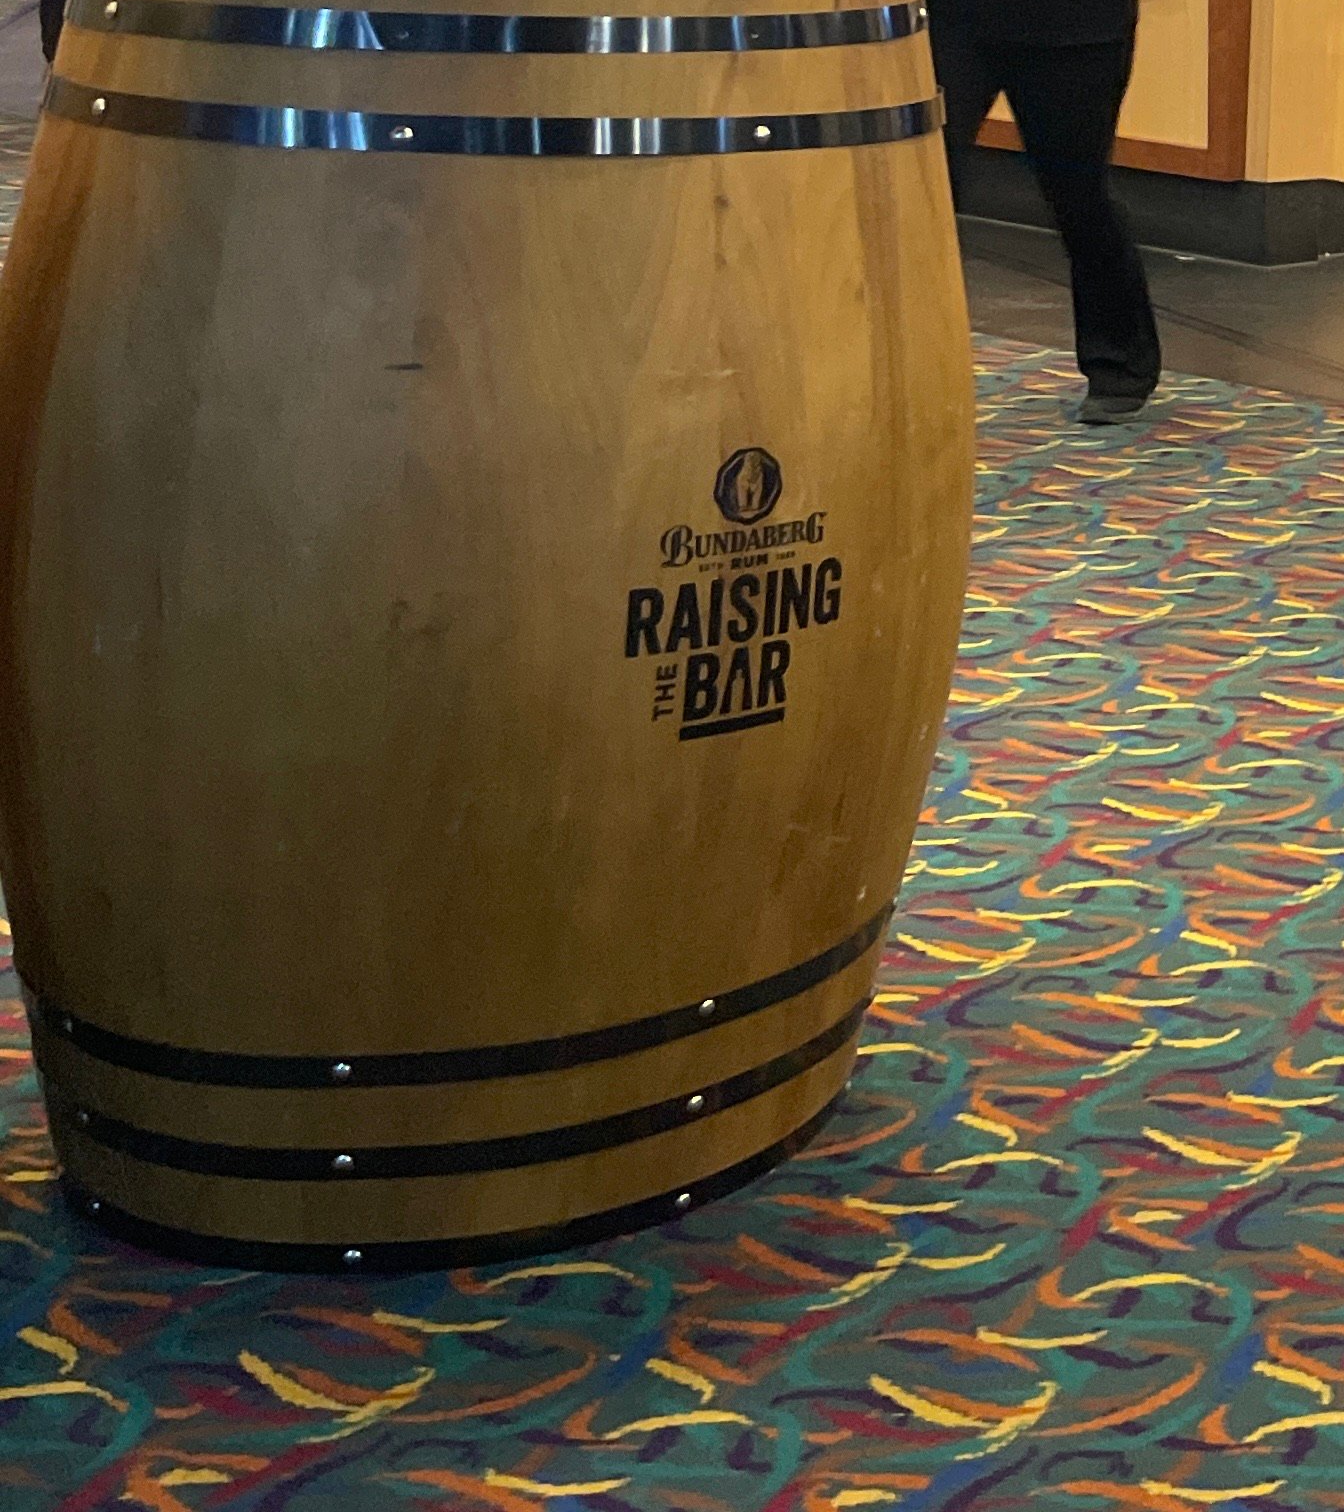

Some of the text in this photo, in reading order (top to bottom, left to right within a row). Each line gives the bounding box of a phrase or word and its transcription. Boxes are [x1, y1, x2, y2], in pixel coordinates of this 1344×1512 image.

[730, 553, 767, 571] RUM
[624, 556, 843, 659] RAISING
[651, 639, 791, 722] THE BAR
